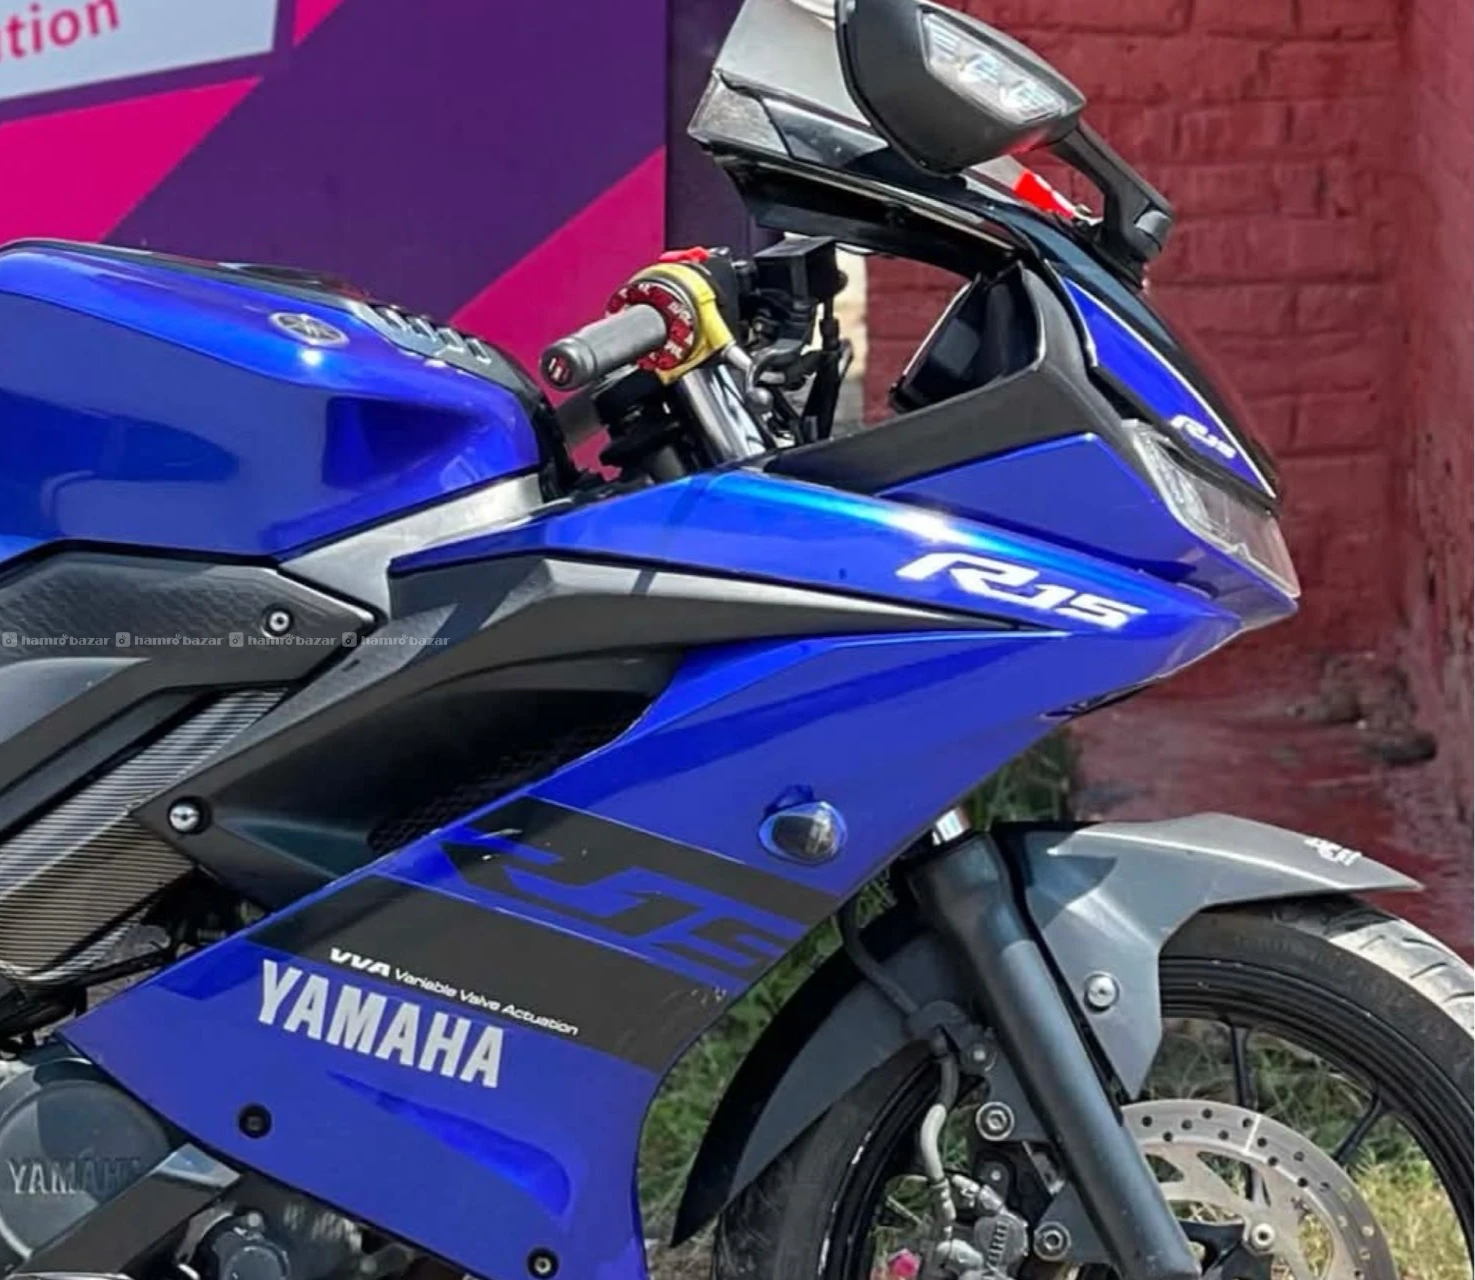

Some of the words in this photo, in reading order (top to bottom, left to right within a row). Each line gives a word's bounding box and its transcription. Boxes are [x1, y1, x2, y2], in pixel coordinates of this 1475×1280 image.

[895, 552, 1148, 630] R15
[257, 959, 505, 1089] YAMAHA
[329, 946, 392, 978] VVA
[394, 967, 458, 997] Variable
[459, 988, 502, 1012] Valve
[501, 1003, 580, 1037] Actuation
[6, 1157, 142, 1195] YAMAH
